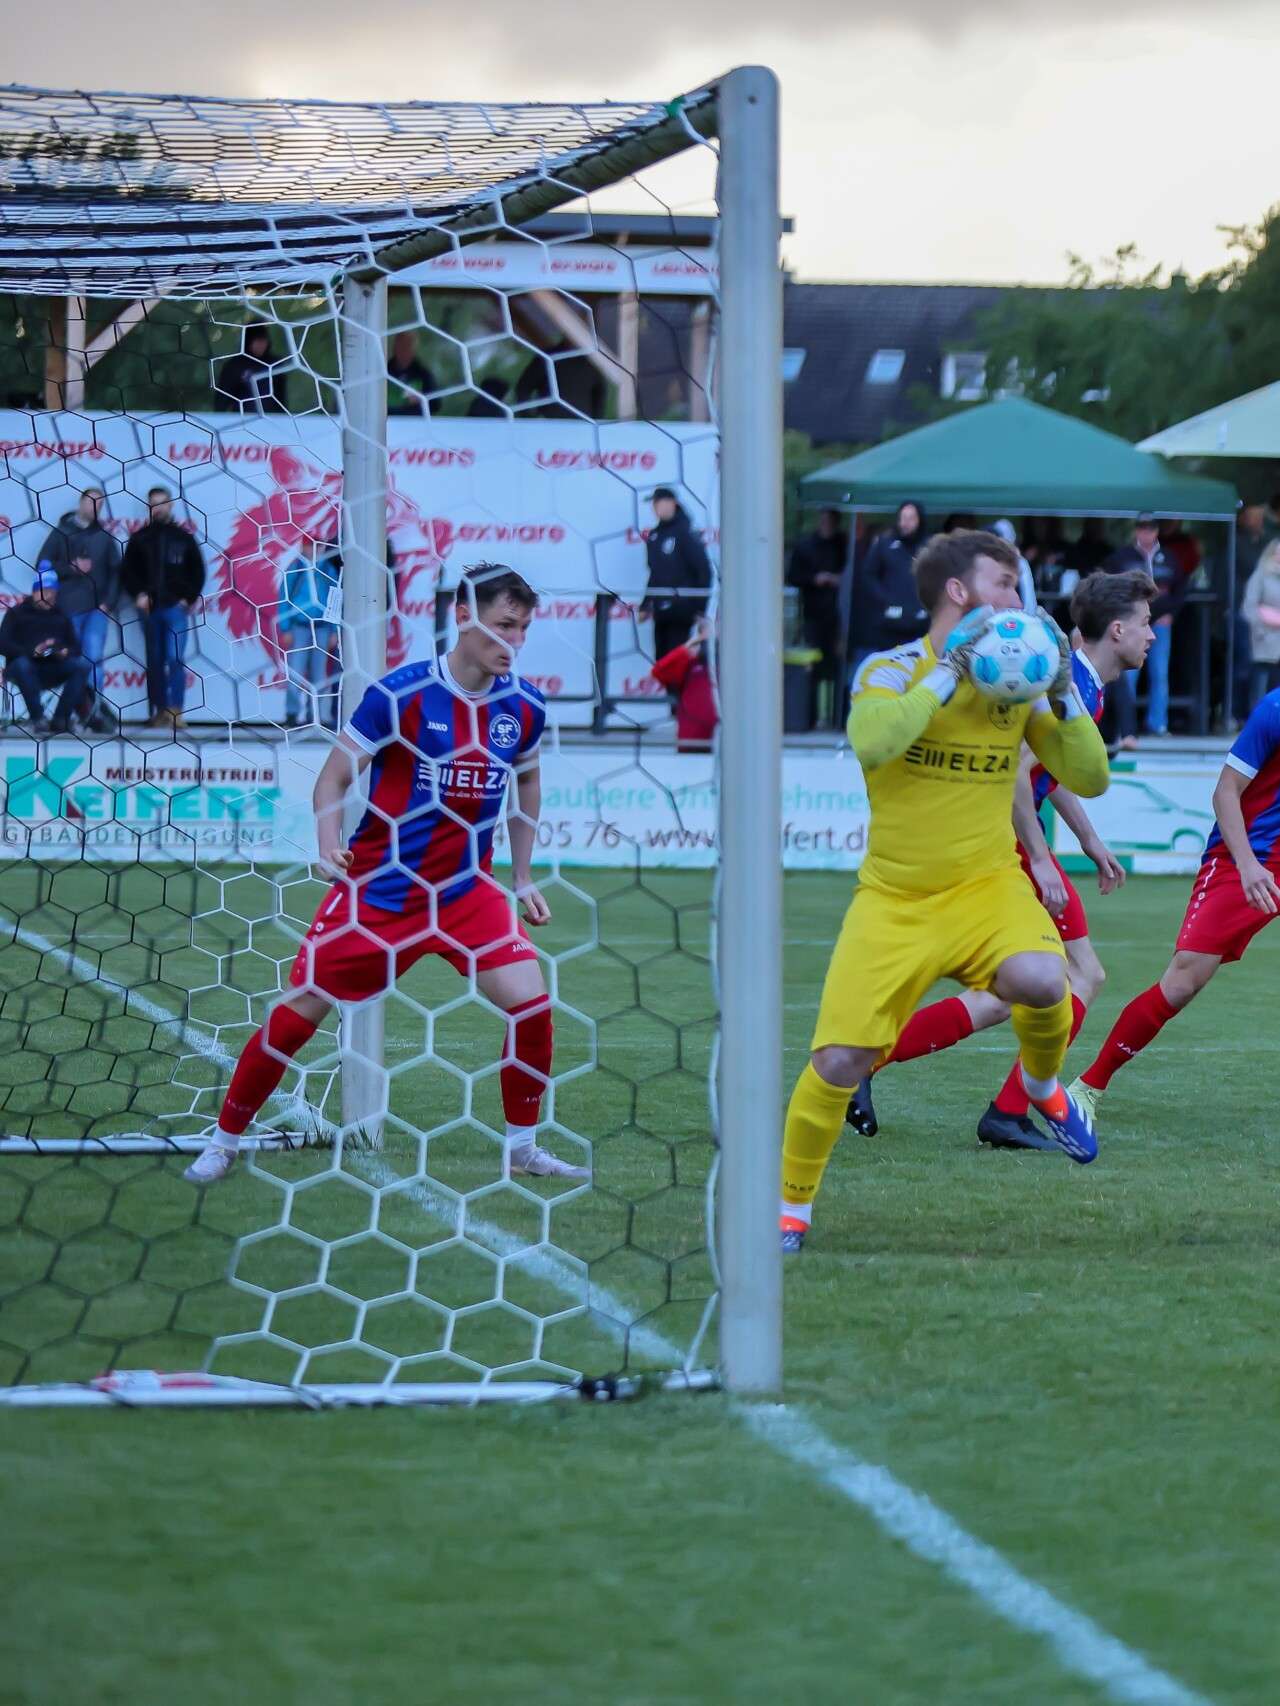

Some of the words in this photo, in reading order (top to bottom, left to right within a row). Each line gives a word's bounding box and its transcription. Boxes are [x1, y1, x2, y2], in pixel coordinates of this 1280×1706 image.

[536, 449, 656, 470] Lexware
[427, 721, 449, 732] JAKO
[105, 767, 274, 782] MEISTERBETRIEB
